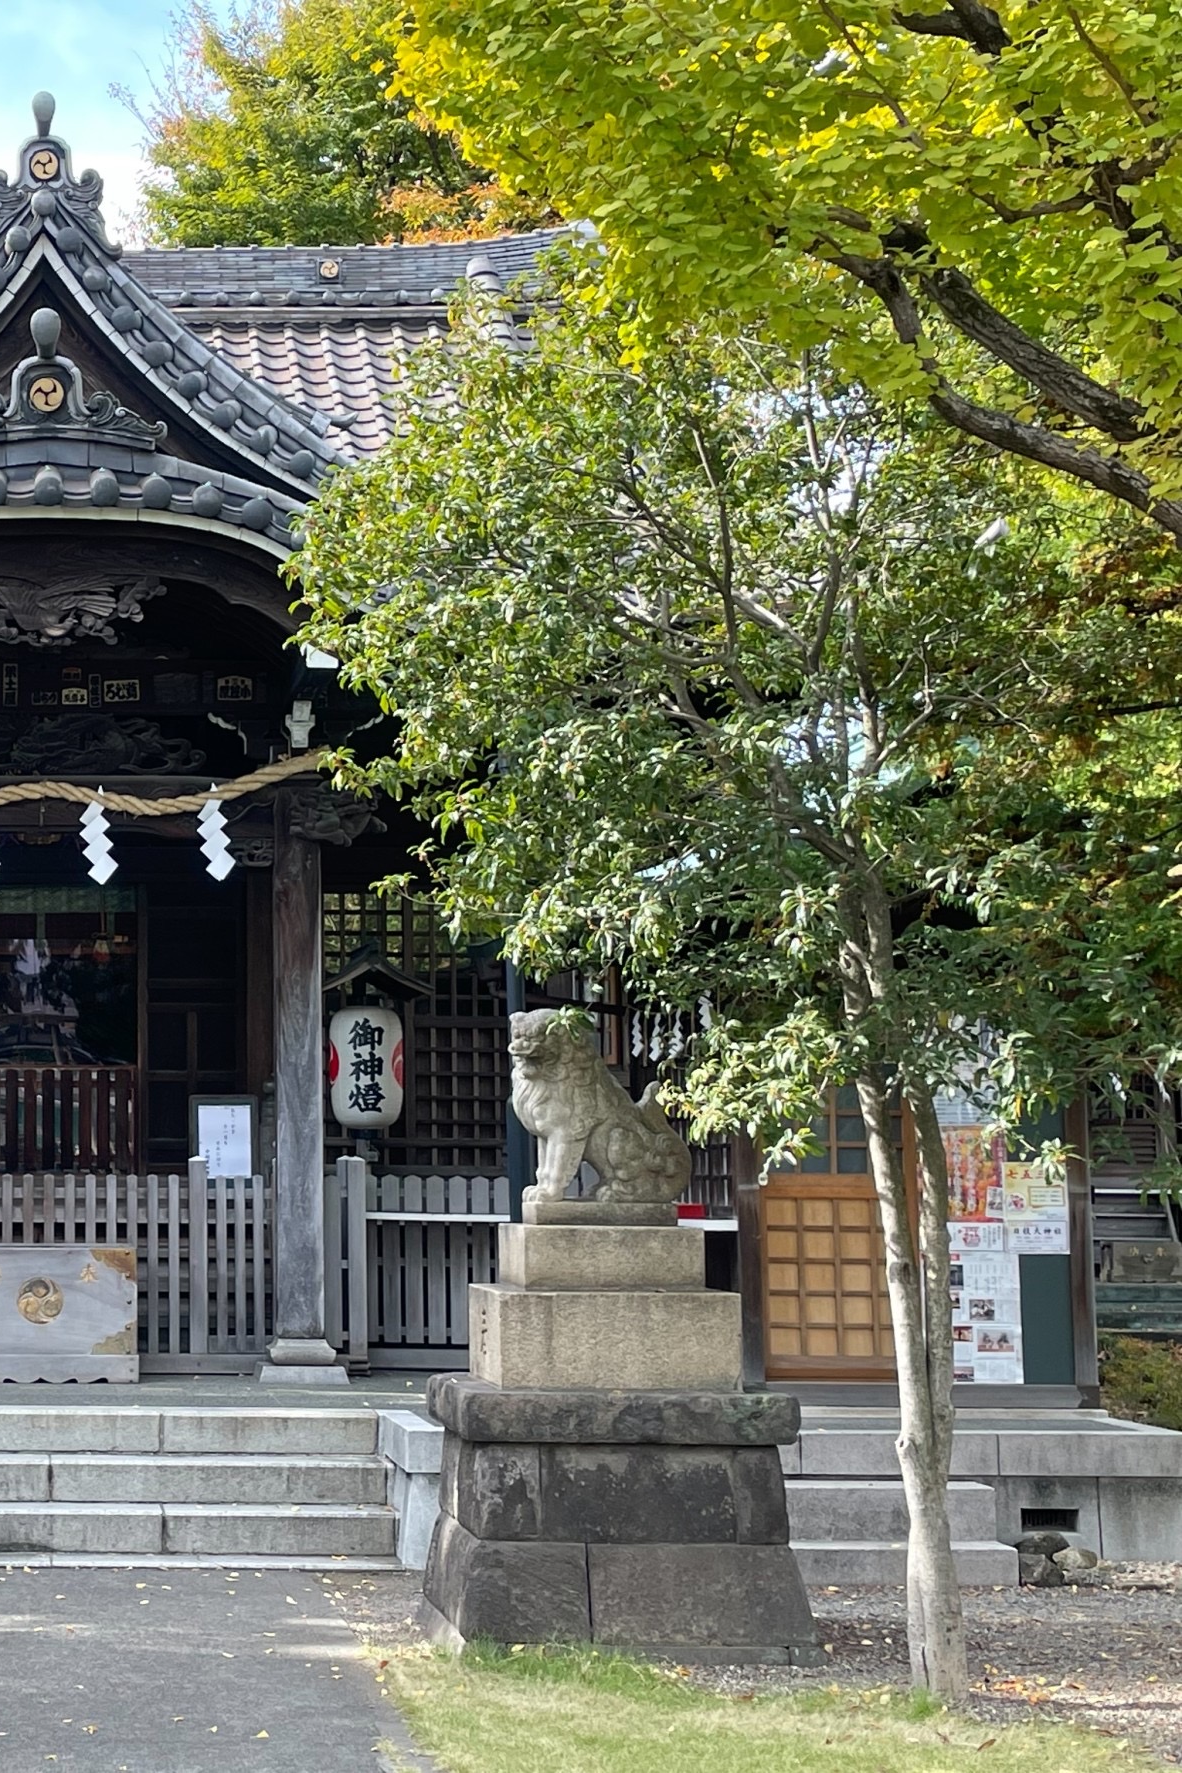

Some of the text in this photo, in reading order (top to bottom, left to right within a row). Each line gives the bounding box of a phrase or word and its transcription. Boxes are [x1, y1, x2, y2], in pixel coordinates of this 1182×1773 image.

[347, 1017, 386, 1113] 御神燈
[1013, 1226, 1062, 1236] 日枝大神社
